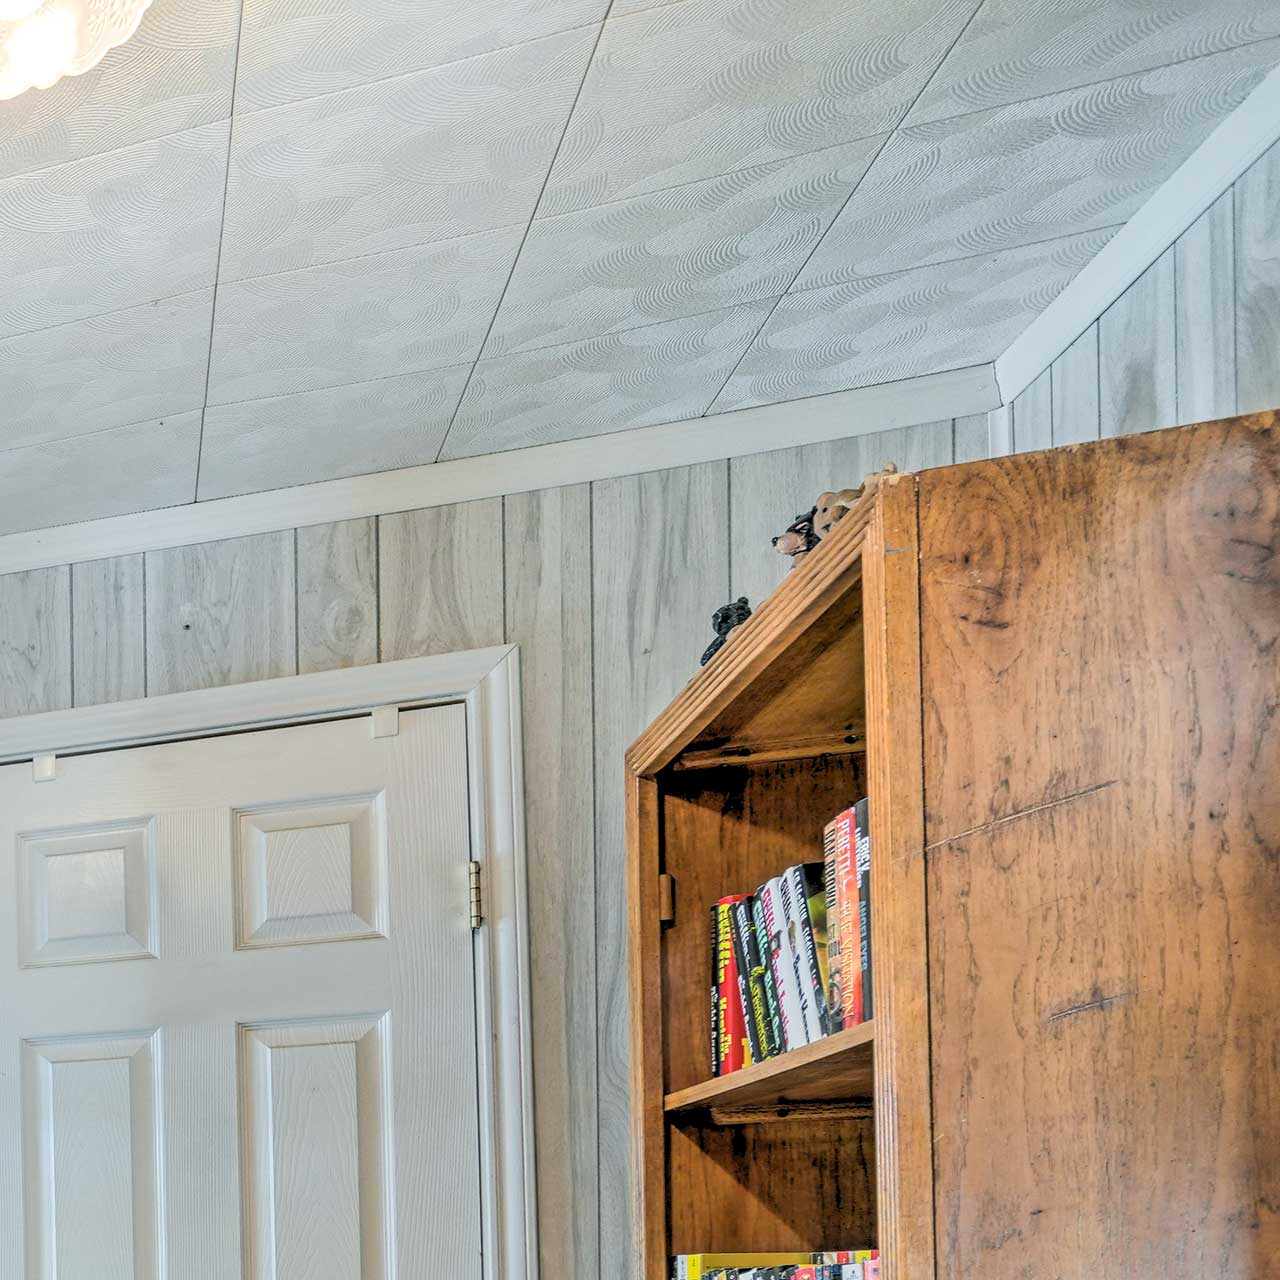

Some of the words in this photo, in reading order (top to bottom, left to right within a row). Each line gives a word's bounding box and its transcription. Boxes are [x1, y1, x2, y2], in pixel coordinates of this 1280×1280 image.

[824, 827, 836, 857] DAN
[837, 819, 850, 876] PERETTI
[860, 836, 870, 862] ERIC
[825, 859, 837, 909] BROWN
